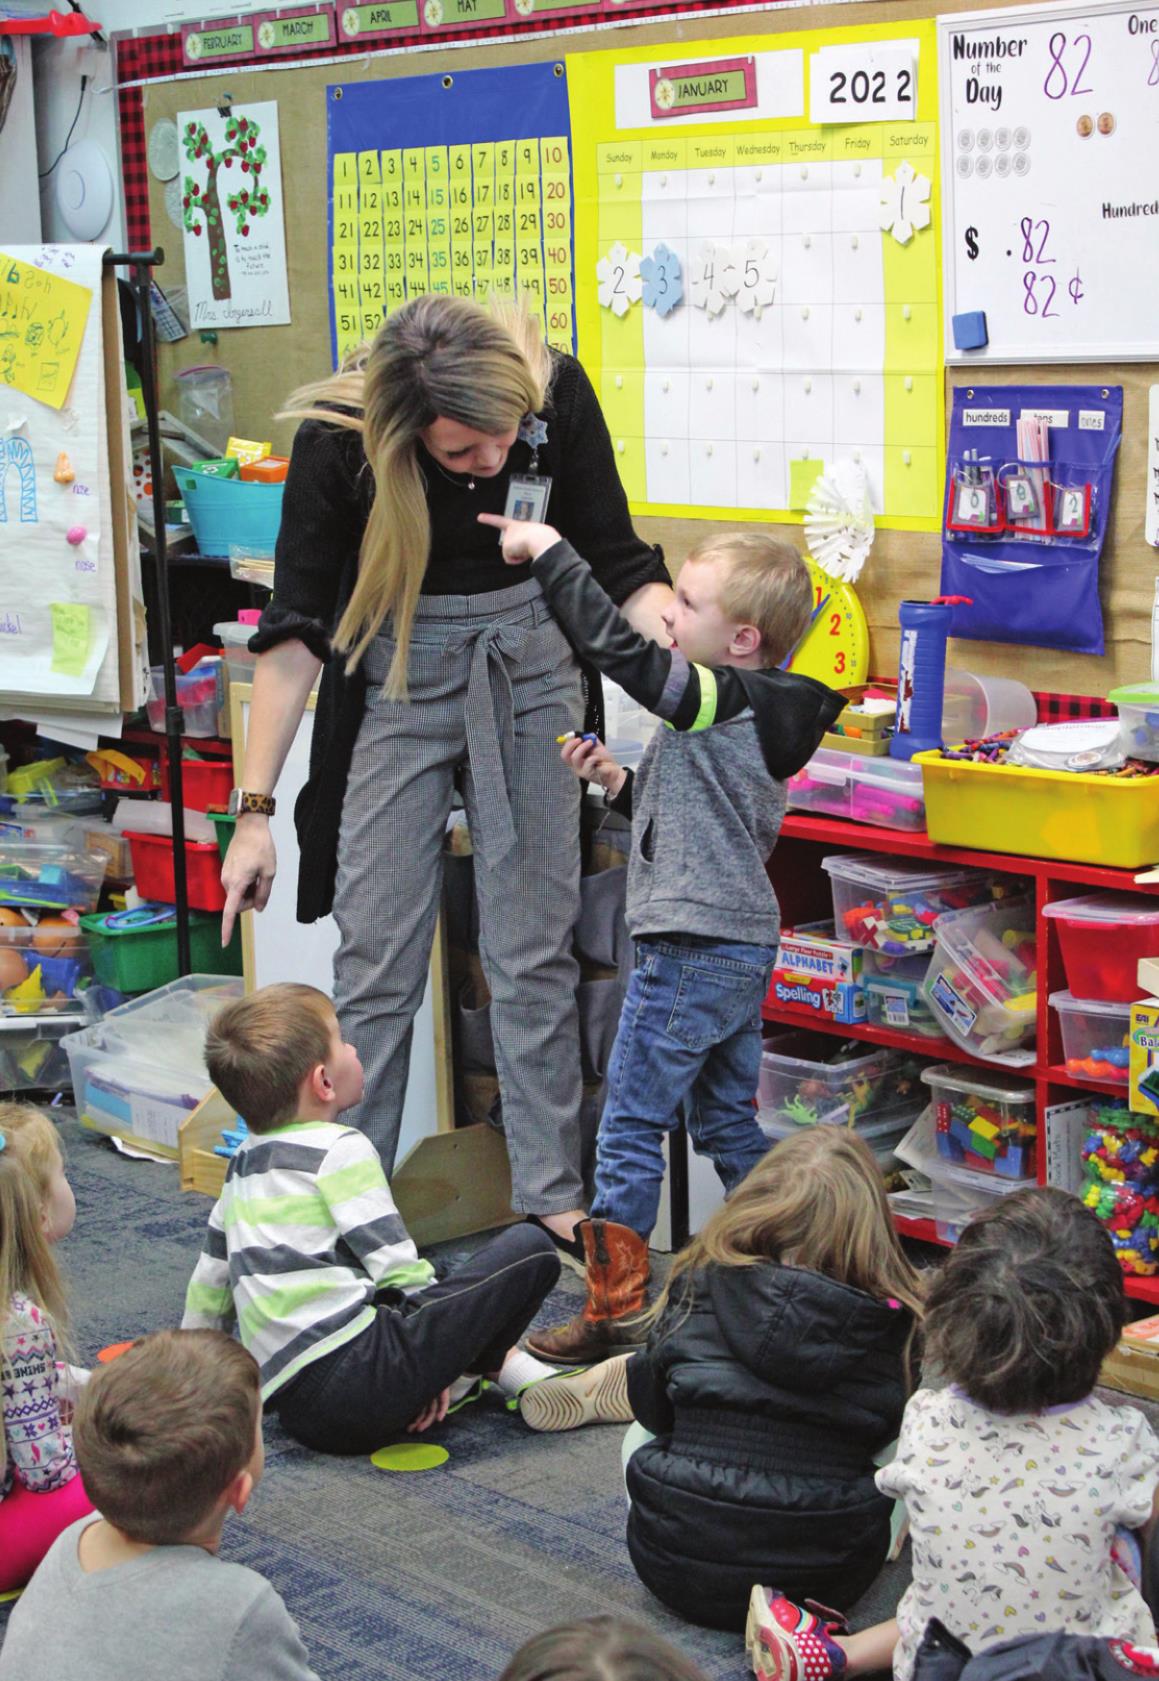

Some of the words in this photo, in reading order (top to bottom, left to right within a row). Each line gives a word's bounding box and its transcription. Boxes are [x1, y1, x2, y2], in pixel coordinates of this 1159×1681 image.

[369, 9, 392, 24] APRIL
[1128, 15, 1158, 35] One
[282, 22, 314, 37] MARCH
[203, 33, 242, 50] FEBRUARY
[953, 34, 1027, 60] Number
[971, 62, 981, 76] of
[986, 62, 1001, 73] the
[1043, 32, 1093, 100] 82
[678, 78, 729, 100] JANUARY
[830, 70, 911, 103] 2022
[966, 77, 1002, 111] Day
[365, 159, 373, 176] 2
[388, 158, 395, 174] 3
[410, 156, 417, 172] 4
[431, 155, 441, 172] 5
[455, 154, 464, 170] 6
[478, 151, 487, 168] 7
[501, 150, 508, 166] 8
[523, 148, 531, 164] 9
[545, 146, 562, 163] 10
[605, 152, 633, 165] Sunday
[650, 150, 678, 163] Monday
[694, 146, 727, 160] Tuesday
[736, 143, 780, 158] Wednesday
[788, 140, 826, 154] Thursday
[844, 137, 872, 150] Friday
[889, 134, 929, 148] Saturday
[339, 193, 351, 209] 11
[363, 193, 377, 209] 12
[386, 191, 399, 207] 13
[407, 190, 420, 206] 14
[430, 189, 444, 206] 15
[453, 187, 467, 203] 16
[477, 185, 490, 202] 17
[498, 184, 509, 201] 18
[520, 183, 534, 200] 19
[547, 182, 565, 199] 20
[1102, 200, 1159, 219] Hundred
[339, 223, 354, 238] 21
[363, 222, 379, 237] 22
[387, 221, 401, 237] 23
[408, 220, 423, 236] 24
[431, 219, 445, 236] 25
[454, 217, 469, 234] 26
[476, 216, 489, 232] 27
[497, 214, 511, 231] 28
[520, 214, 537, 230] 29
[547, 212, 565, 229] 30
[965, 226, 979, 260] $
[338, 254, 353, 270] 31
[363, 254, 380, 270] 32
[388, 253, 401, 269] 33
[408, 252, 423, 268] 34
[432, 251, 447, 268] 35
[455, 251, 470, 267] 36
[476, 250, 489, 267] 37
[497, 248, 511, 265] 38
[521, 248, 538, 265] 39
[548, 247, 566, 264] 40
[338, 284, 354, 299] 41
[363, 283, 381, 299] 42
[388, 282, 402, 298] 43
[409, 282, 426, 296] 44
[432, 281, 448, 296] 45
[456, 281, 470, 296] 46
[477, 279, 490, 295] 47
[522, 279, 540, 295] 49
[549, 278, 567, 294] 50
[613, 266, 625, 294] 2
[659, 265, 668, 295] 3
[703, 262, 715, 291] 4
[743, 260, 760, 288] 5
[1023, 271, 1060, 318] 82
[341, 314, 356, 331] 51
[550, 312, 567, 329] 60
[966, 412, 1008, 423] hundreds
[815, 586, 822, 606] 1
[829, 613, 841, 636] 2
[834, 652, 846, 674] 3
[782, 952, 833, 974] ALPHABET
[775, 984, 821, 1008] Spelling
